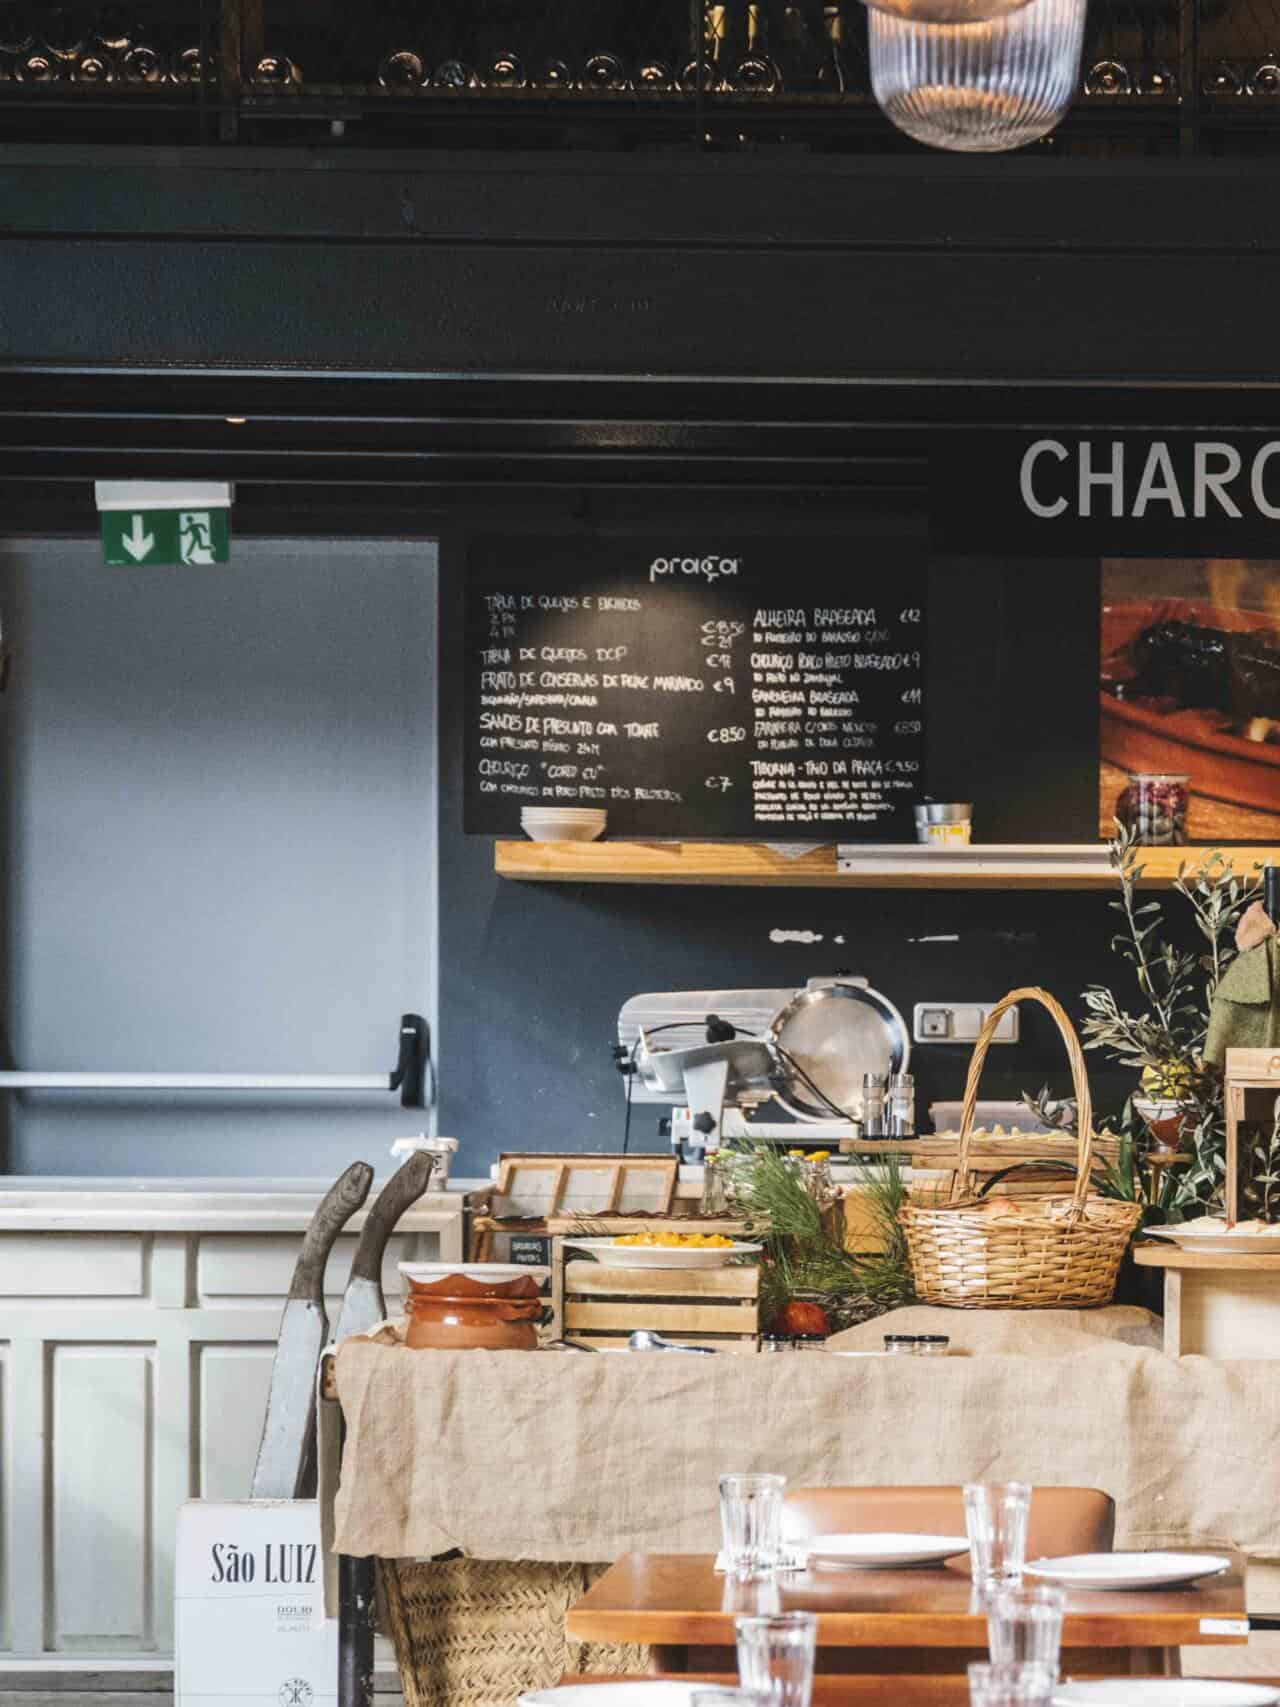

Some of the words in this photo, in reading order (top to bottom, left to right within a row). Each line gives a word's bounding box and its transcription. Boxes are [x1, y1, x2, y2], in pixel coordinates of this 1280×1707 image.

[649, 555, 738, 583] praça
[211, 1542, 256, 1584] São
[264, 1543, 317, 1584] LUIZ
